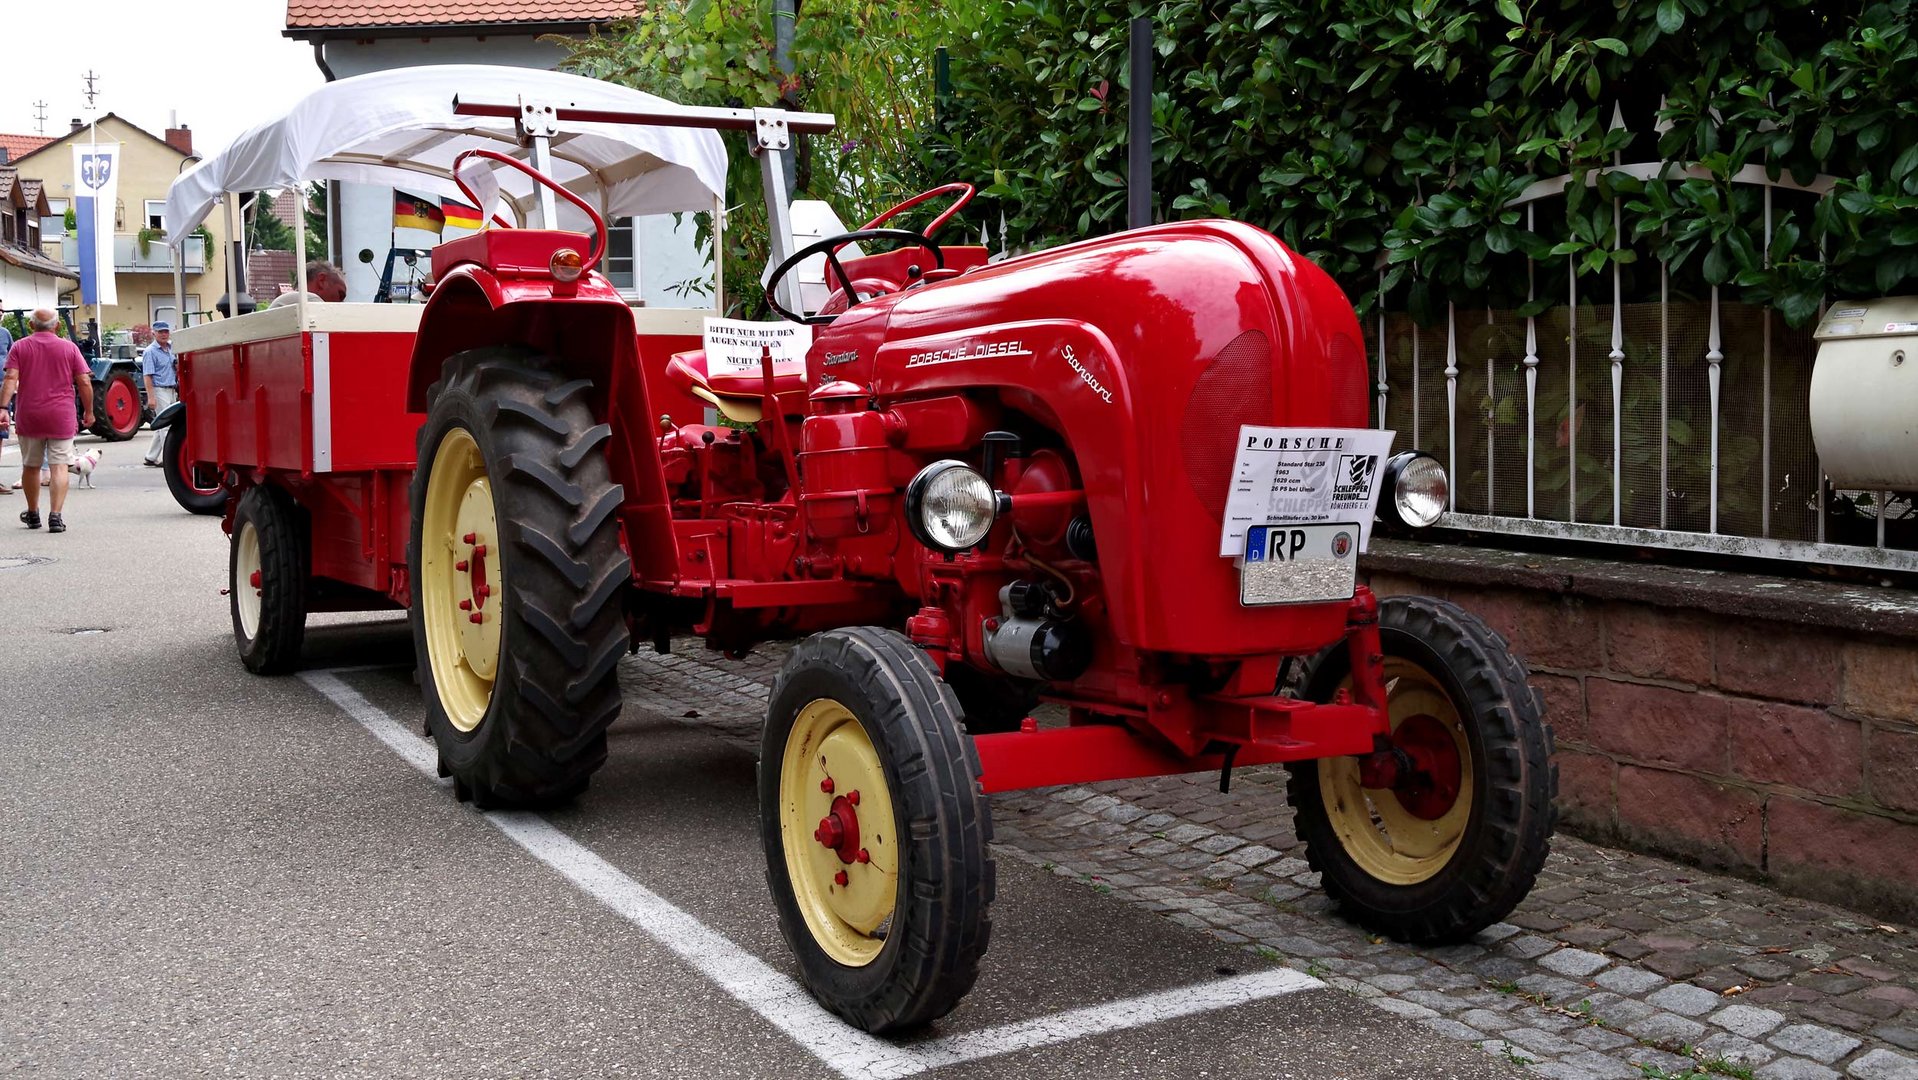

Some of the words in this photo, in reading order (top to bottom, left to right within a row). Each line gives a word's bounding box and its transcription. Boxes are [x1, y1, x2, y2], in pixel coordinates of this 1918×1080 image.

[709, 326, 735, 335] BITTE
[737, 328, 756, 337] NUR
[758, 330, 776, 338] MIT
[710, 337, 738, 346] AUGEN
[909, 346, 967, 366] PORSCHE
[975, 340, 1029, 358] DIESEL
[726, 356, 753, 365] NICHT
[1060, 344, 1112, 404] Standard
[1247, 436, 1344, 449] PORSCHE
[1333, 485, 1369, 493] SCHLEPPER
[1332, 493, 1361, 501] FREUNDE
[1270, 530, 1306, 562] RP
[1251, 549, 1260, 561] D
